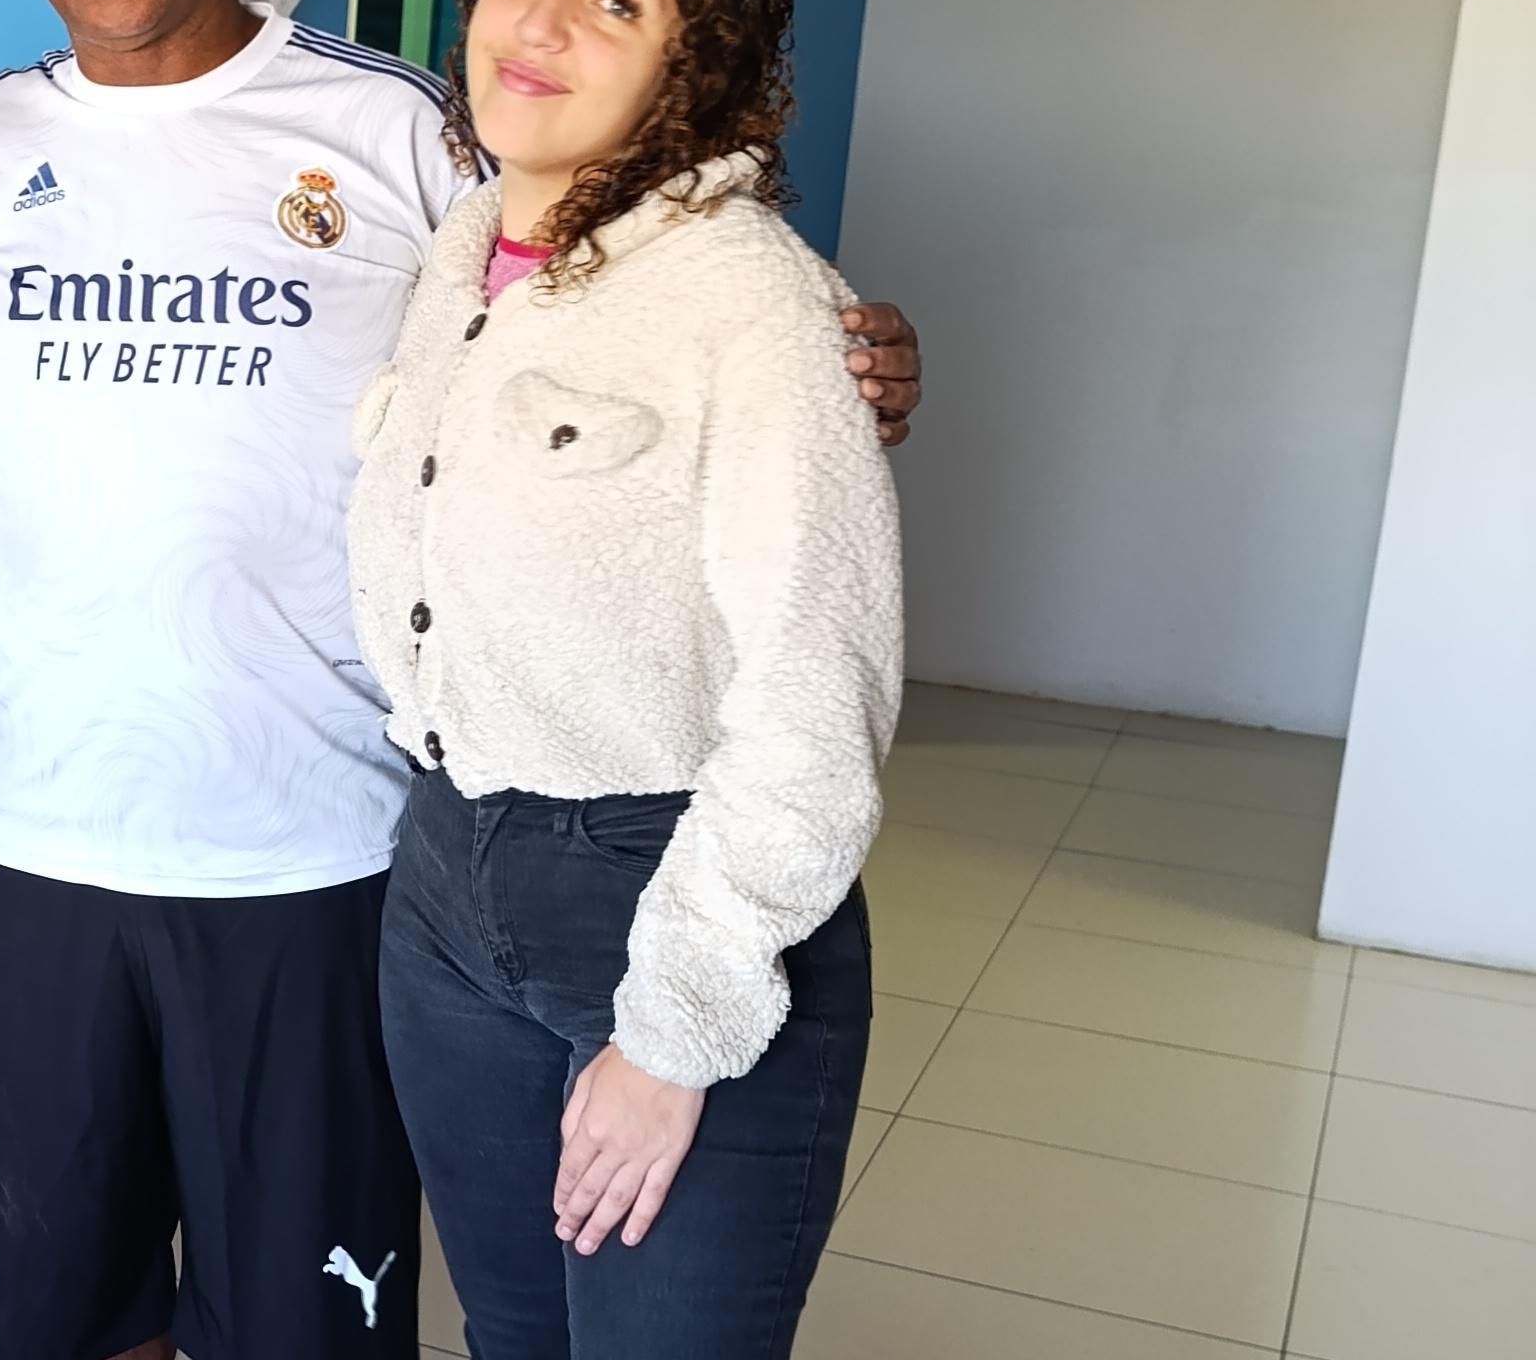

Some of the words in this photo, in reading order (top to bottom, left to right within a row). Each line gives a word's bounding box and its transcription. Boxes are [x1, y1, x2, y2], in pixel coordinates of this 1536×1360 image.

[13, 189, 66, 212] adidas
[8, 258, 313, 328] Emirates
[36, 341, 103, 382] FLY
[112, 342, 273, 387] BETTER
